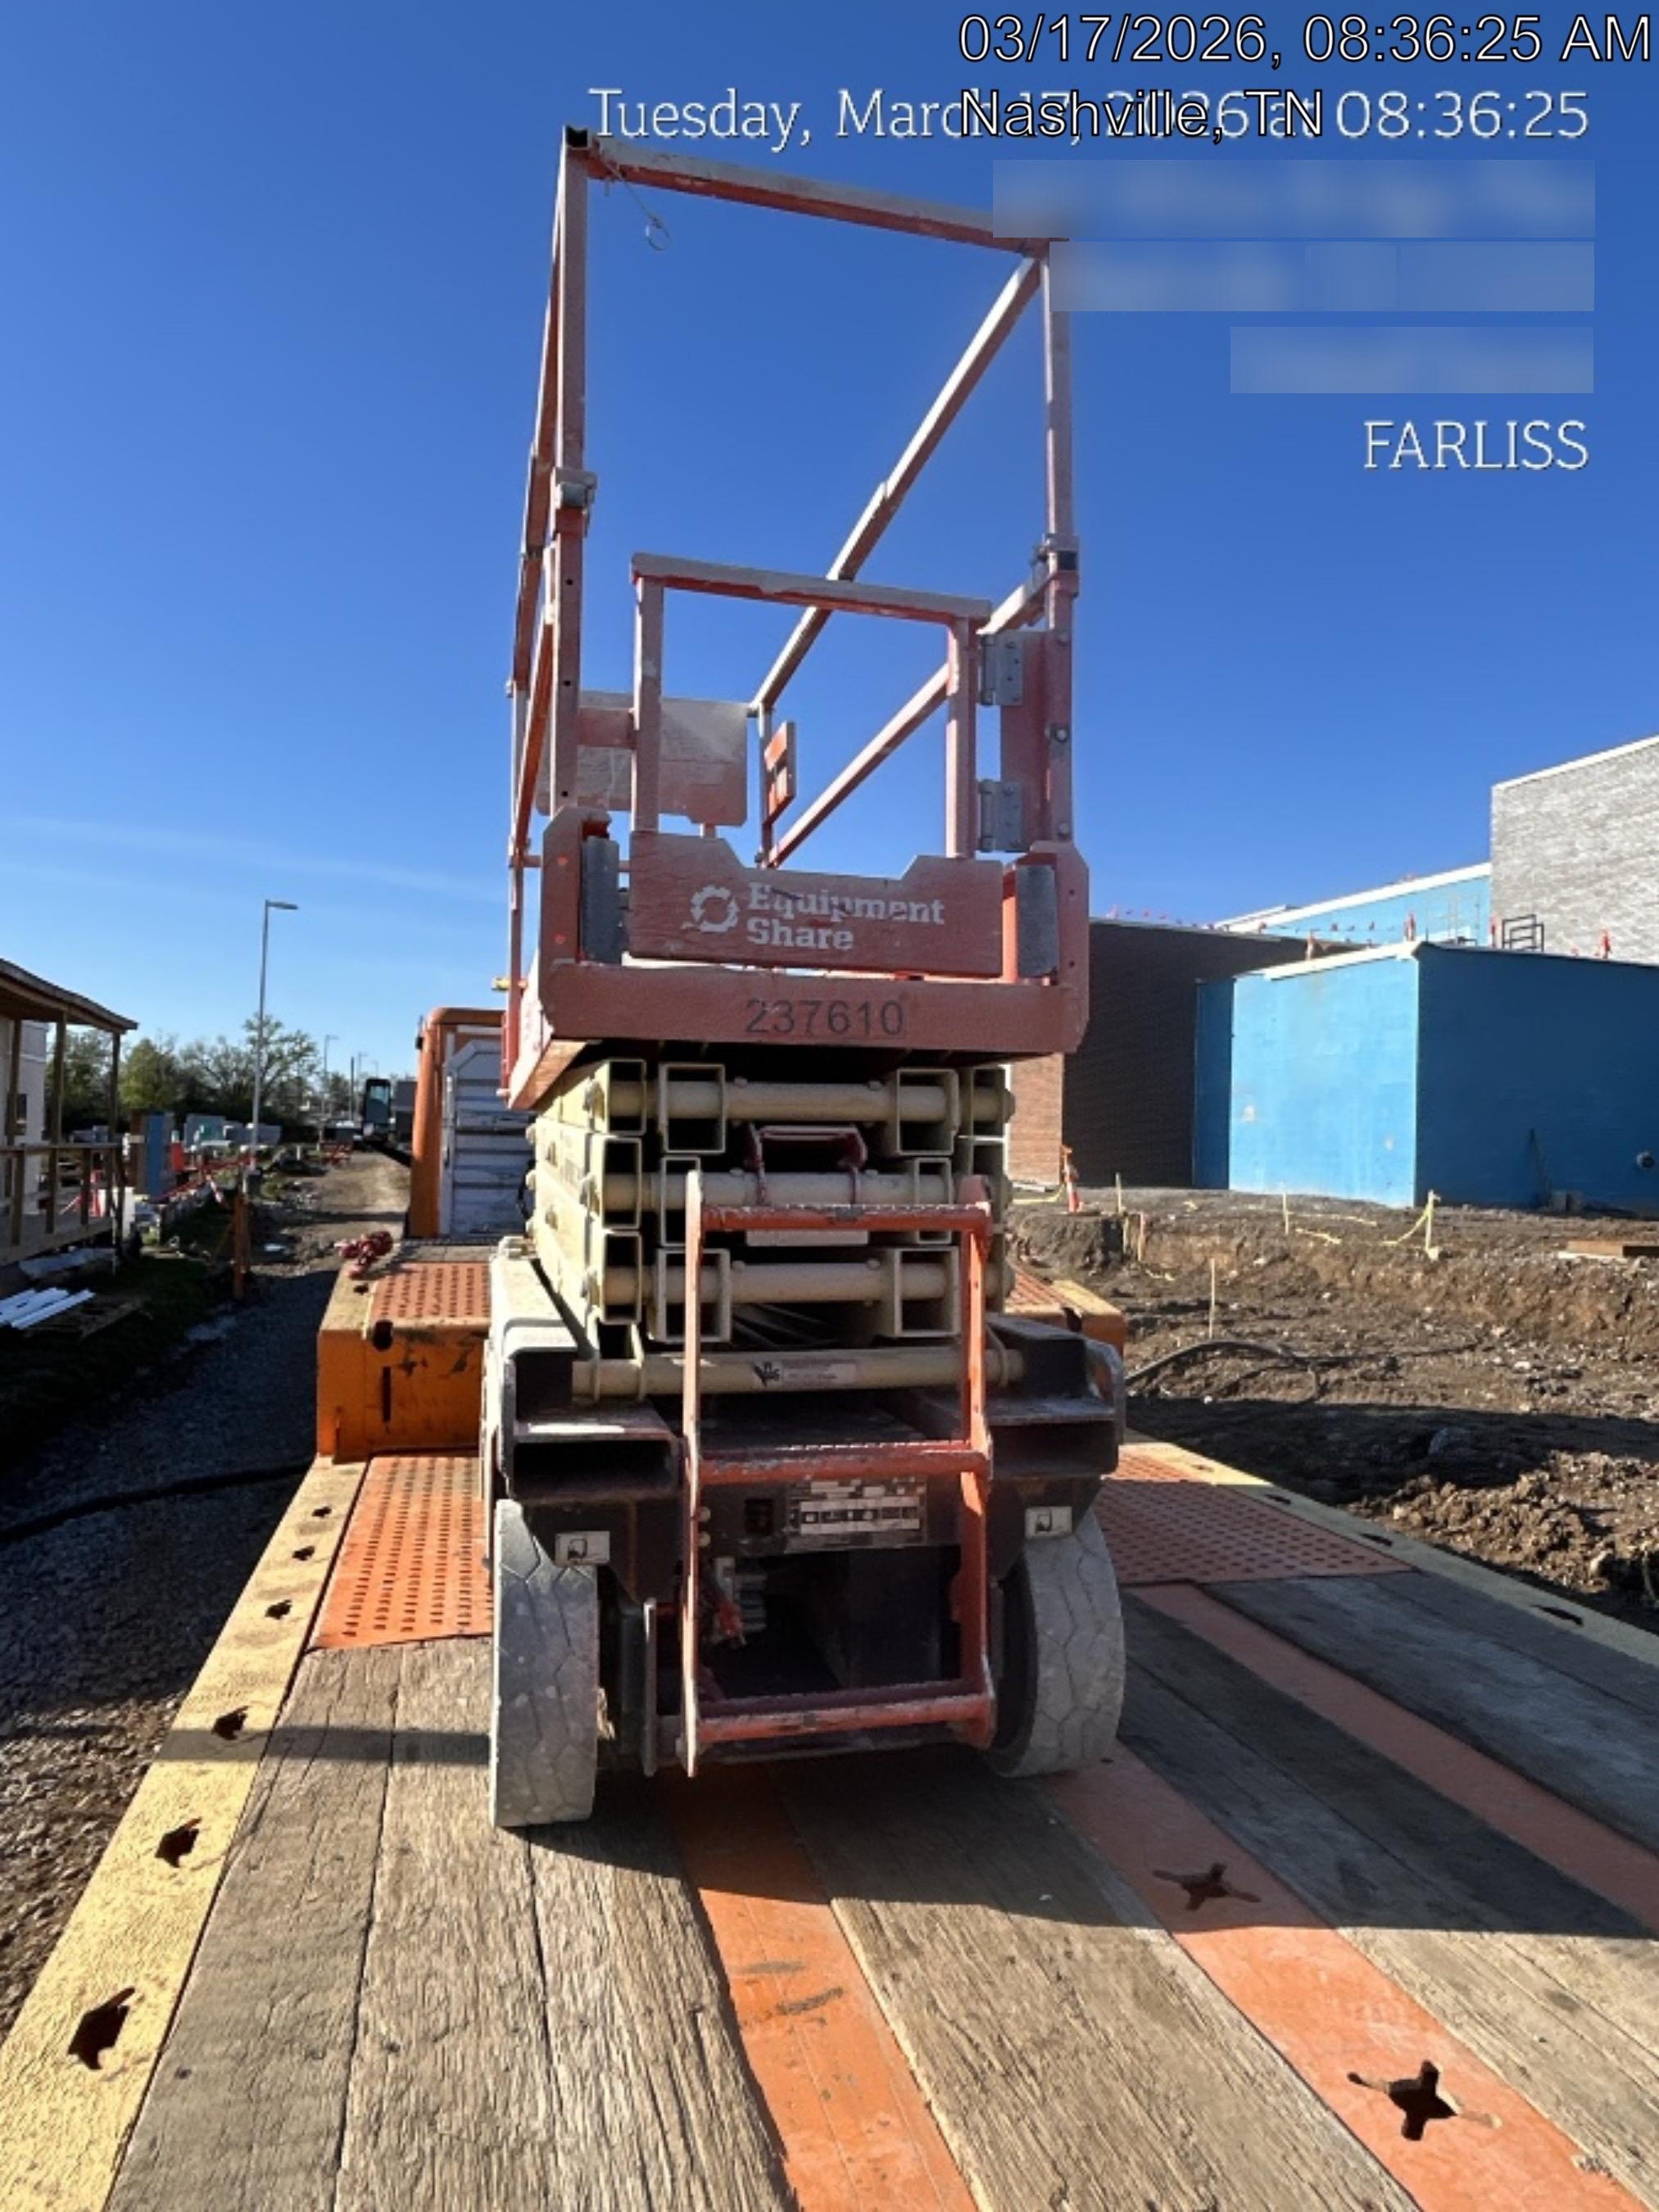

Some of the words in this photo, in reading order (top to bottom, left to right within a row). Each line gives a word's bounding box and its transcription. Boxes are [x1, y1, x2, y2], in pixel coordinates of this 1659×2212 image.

[748, 882, 945, 925] Equipment
[746, 917, 854, 951] Share
[746, 997, 905, 1036] 237610
